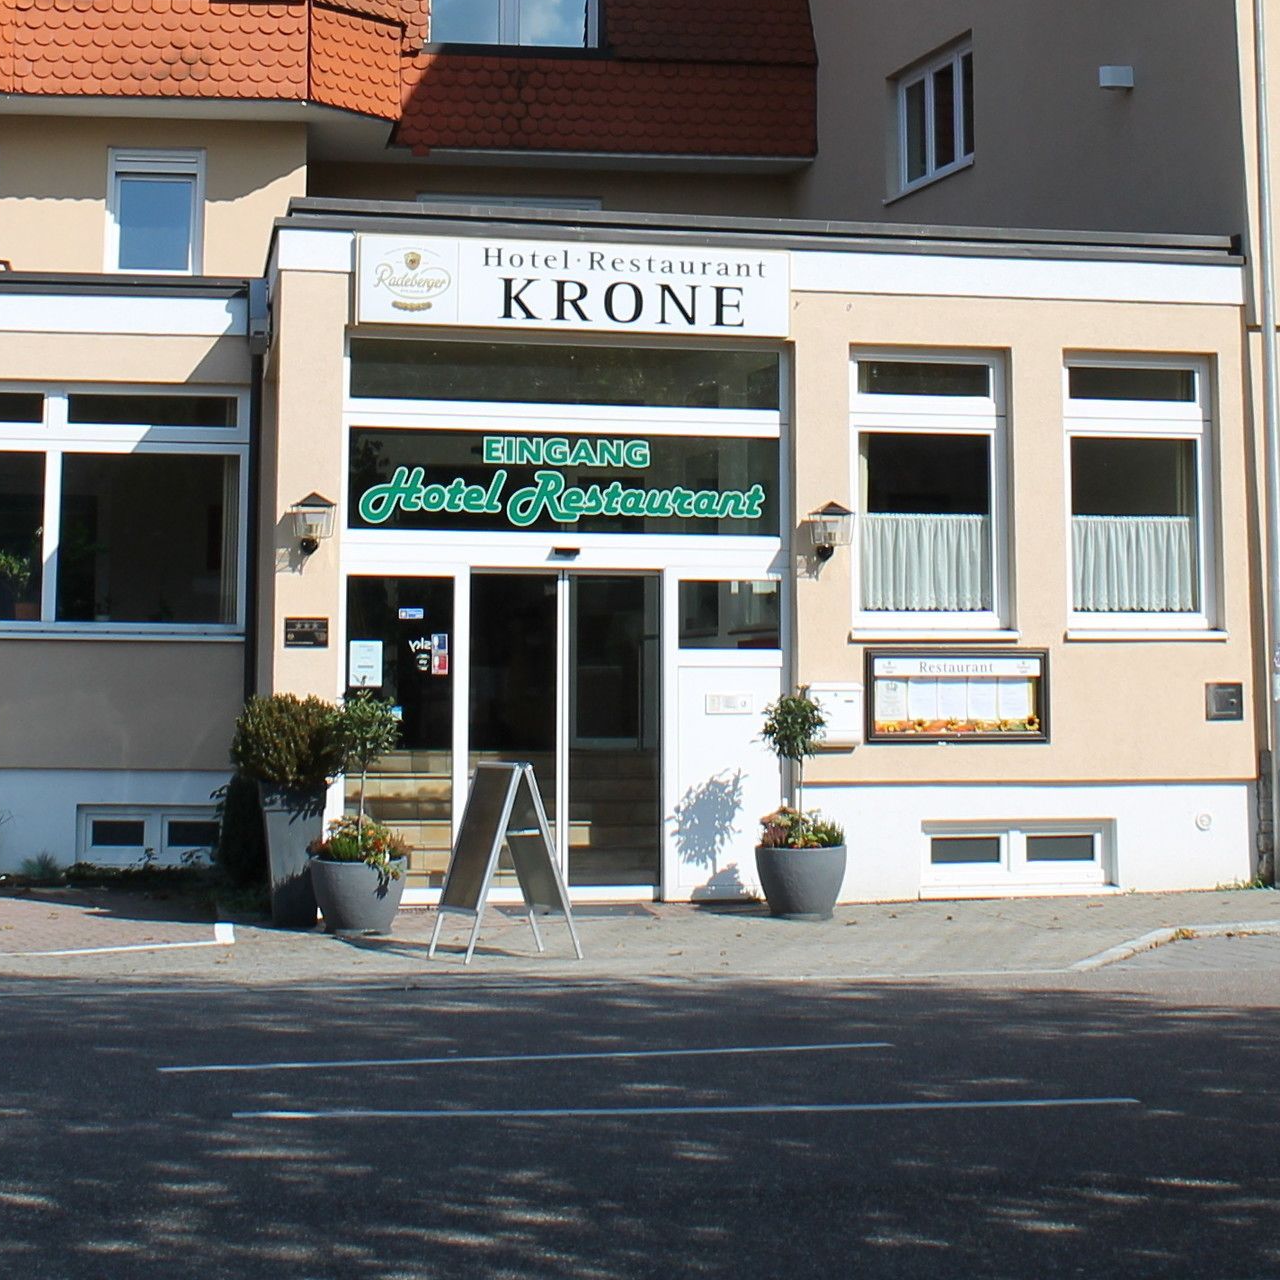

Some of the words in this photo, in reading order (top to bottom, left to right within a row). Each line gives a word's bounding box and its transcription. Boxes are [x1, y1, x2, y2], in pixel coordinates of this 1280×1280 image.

[373, 263, 448, 294] Radeberger
[497, 276, 746, 328] KRONE
[482, 435, 651, 468] EINGANG
[358, 466, 507, 524] Hotel
[507, 470, 766, 527] Restaurant
[919, 661, 993, 673] Restaurant
